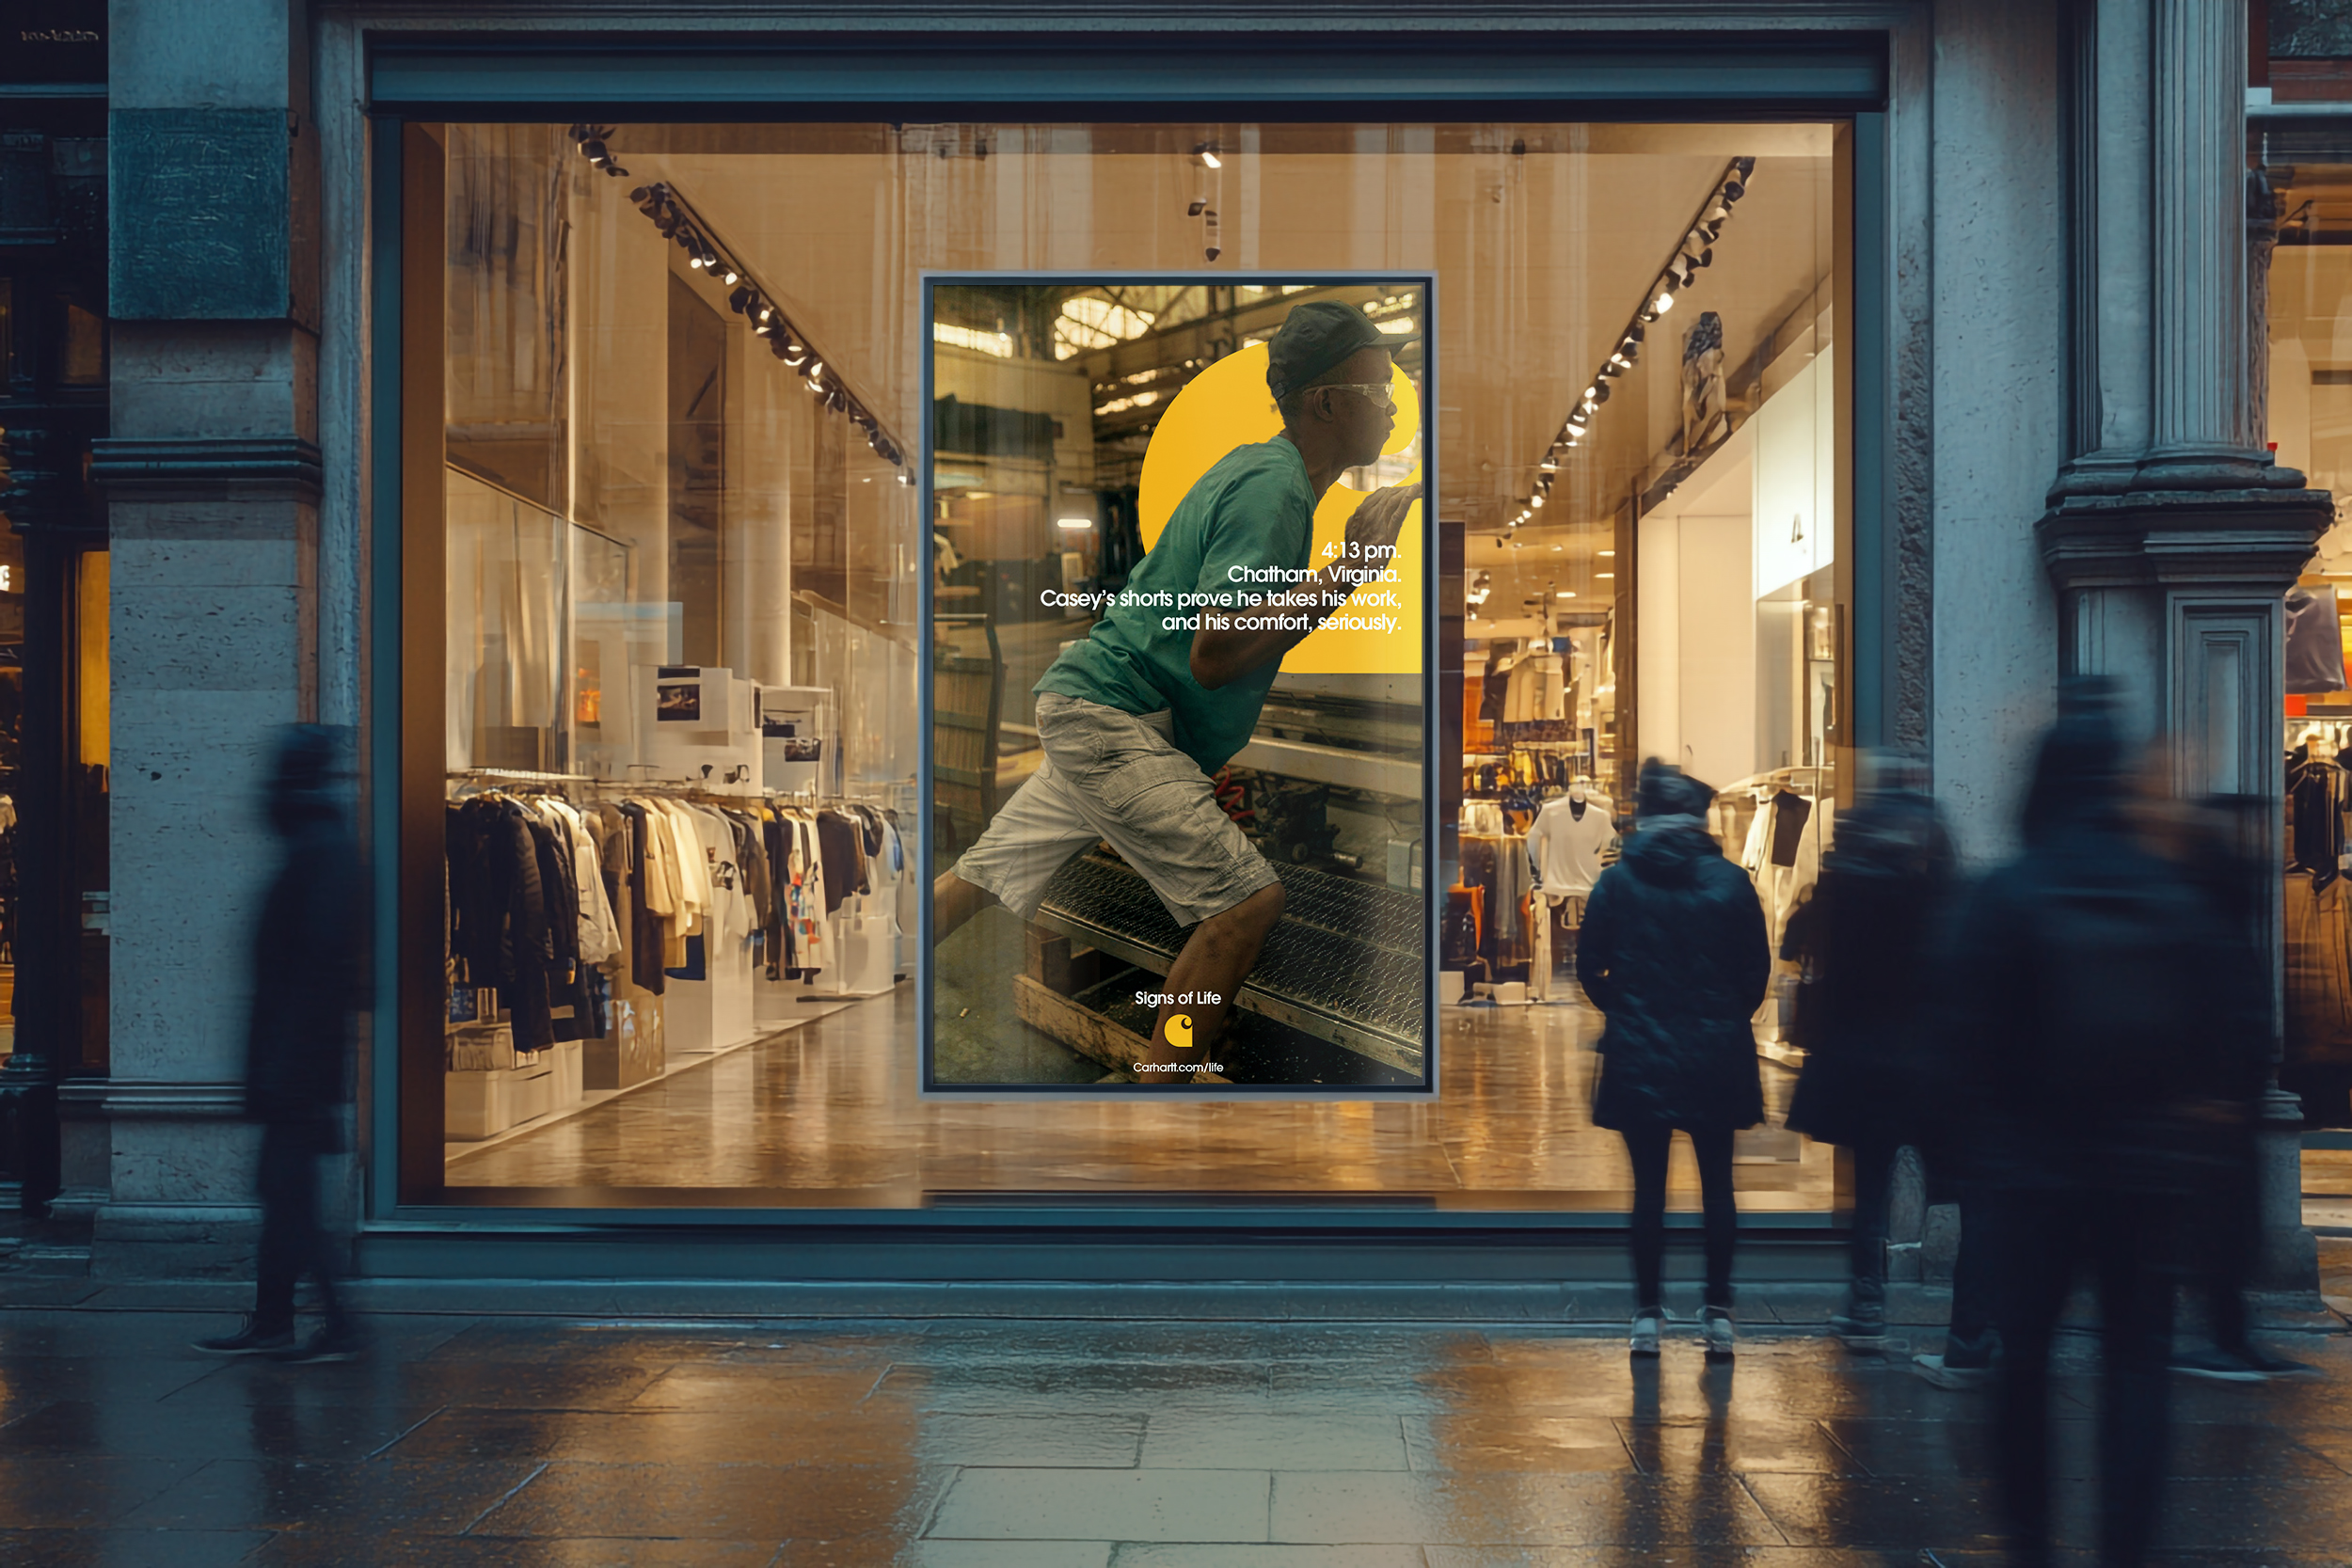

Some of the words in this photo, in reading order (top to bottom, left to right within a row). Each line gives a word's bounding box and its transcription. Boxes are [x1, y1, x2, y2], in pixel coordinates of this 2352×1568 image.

[1321, 542, 1360, 559] 4:13
[1364, 546, 1402, 562] pm.
[1227, 565, 1323, 586] Chatham,
[1327, 565, 1402, 588] Virginia.
[1120, 590, 1173, 608] shorts
[1177, 593, 1233, 610] prove
[1237, 590, 1263, 607] he
[1266, 590, 1318, 607] takes
[1322, 590, 1347, 607] his
[1350, 590, 1402, 610] work,
[1161, 613, 1200, 631] and
[1205, 613, 1231, 631] his
[1234, 613, 1312, 633] comfort,
[1317, 613, 1402, 635] seriously.
[1135, 990, 1175, 1008] Signs
[1178, 990, 1194, 1005] of
[1197, 990, 1222, 1005] Life
[1133, 1062, 1224, 1073] Carhartt.com/life
